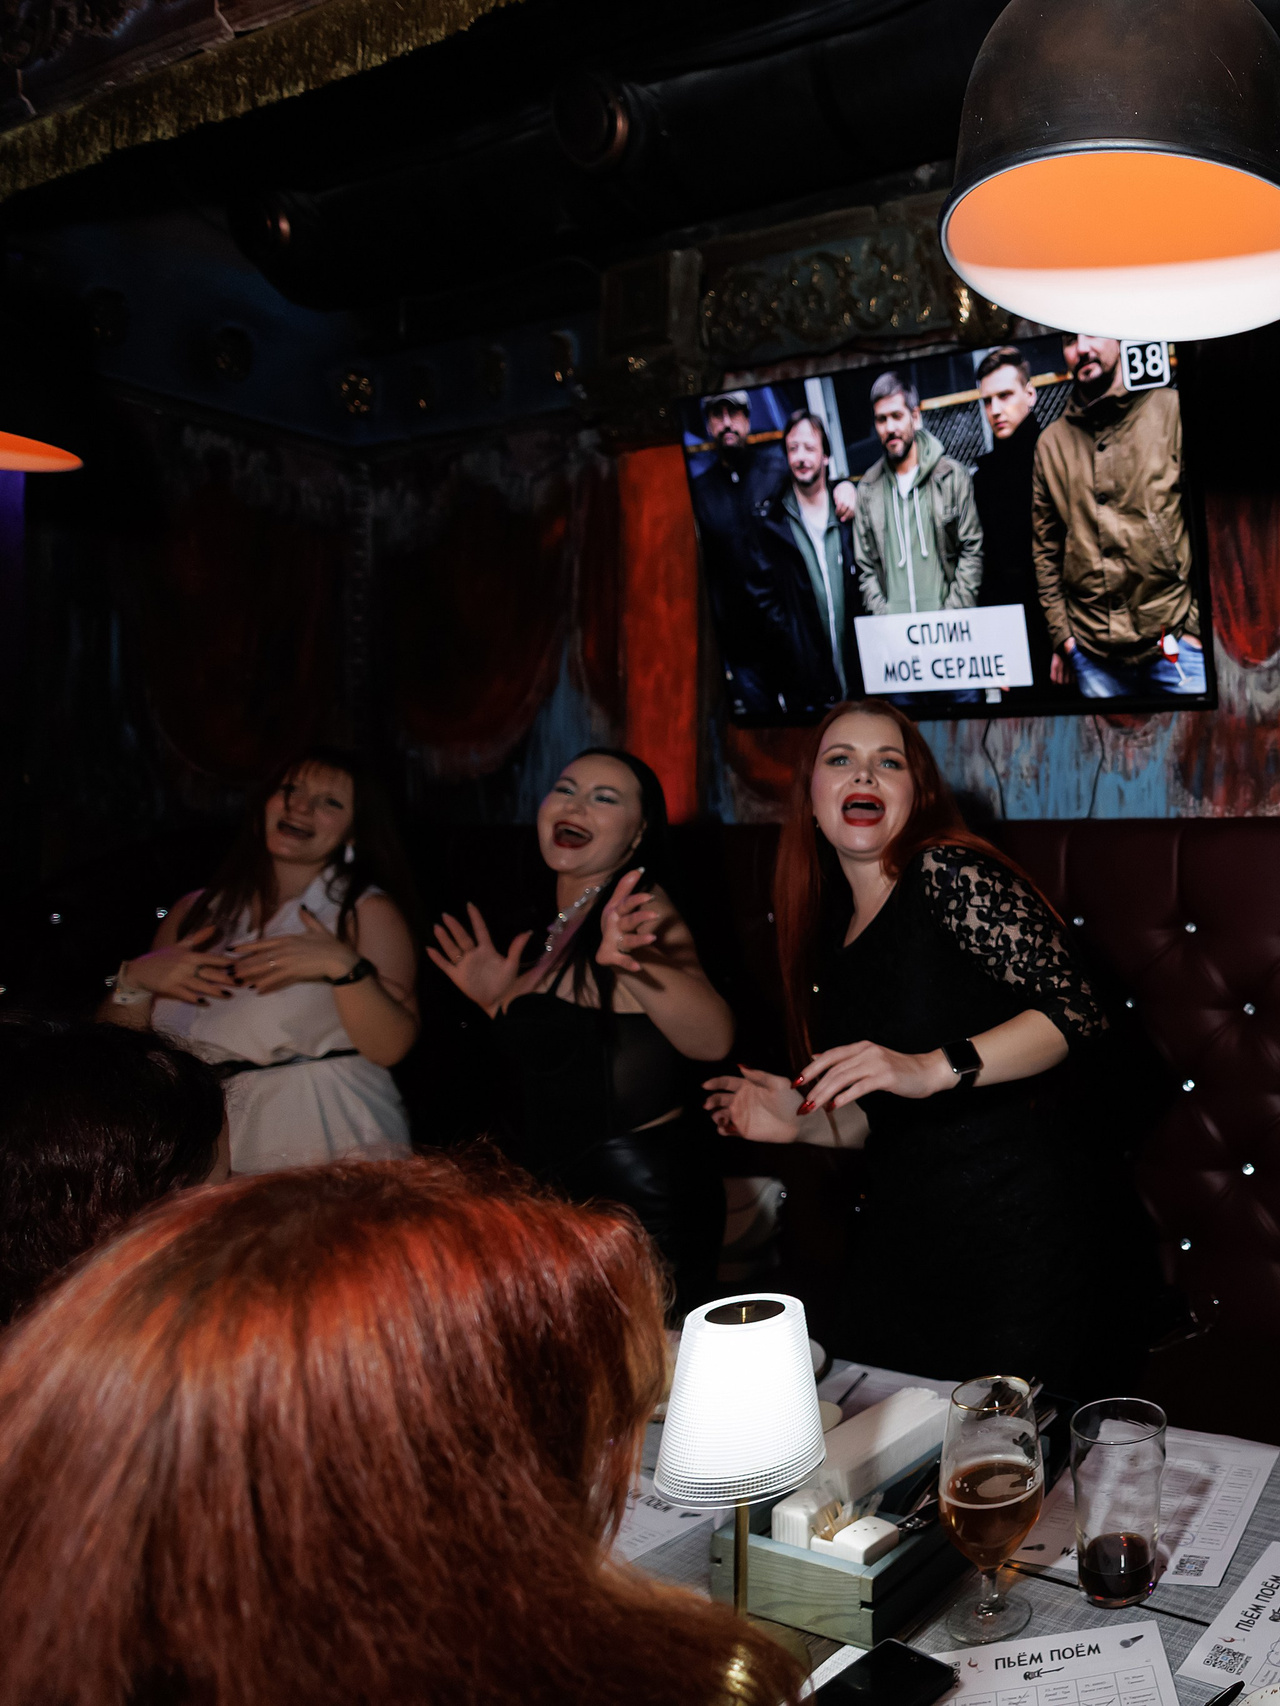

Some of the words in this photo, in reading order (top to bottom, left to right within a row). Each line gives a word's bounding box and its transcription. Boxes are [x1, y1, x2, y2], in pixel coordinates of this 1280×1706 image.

[1127, 343, 1164, 380] 38
[907, 621, 972, 645] СПЛИН
[884, 655, 923, 683] МОЁ
[931, 654, 1005, 679] СЕРДЦЕ
[1235, 1603, 1267, 1632] ПЬЁМ
[994, 1652, 1044, 1670] ПЬЁМ
[1050, 1642, 1102, 1662] ПОЁМ
